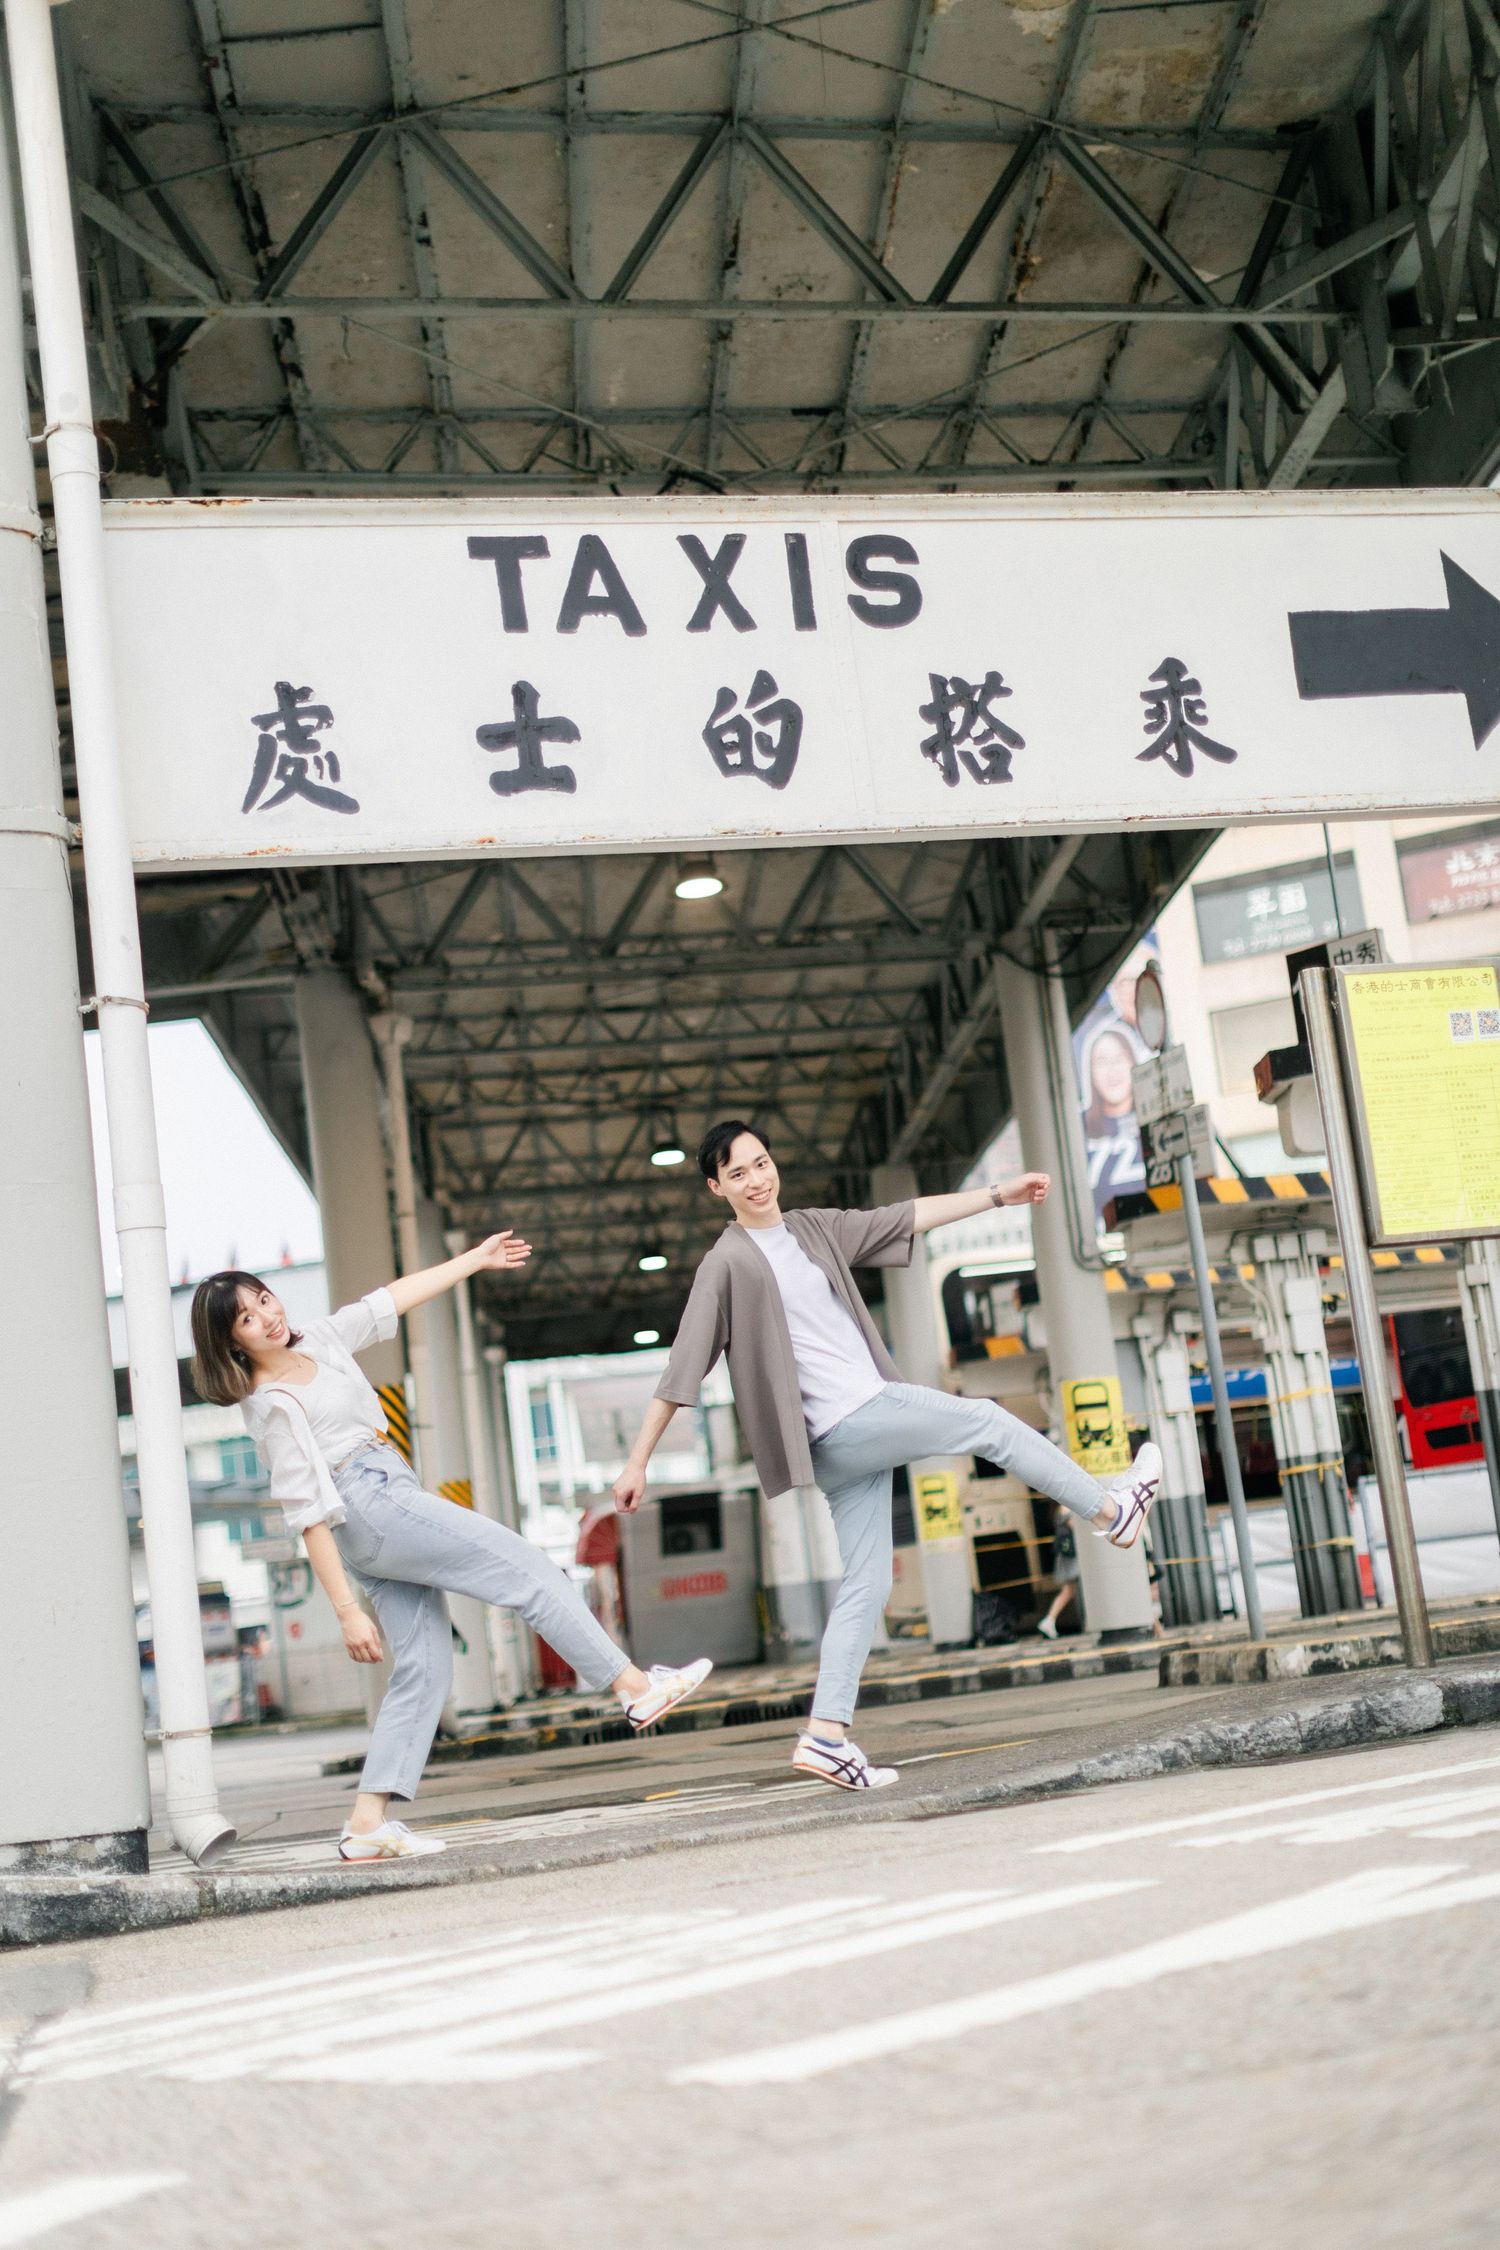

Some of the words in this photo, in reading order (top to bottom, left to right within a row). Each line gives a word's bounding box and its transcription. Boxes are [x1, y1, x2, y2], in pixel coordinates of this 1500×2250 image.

[467, 533, 923, 636] TAXIS
[1351, 973, 1493, 995] 香港的士商會有限公司
